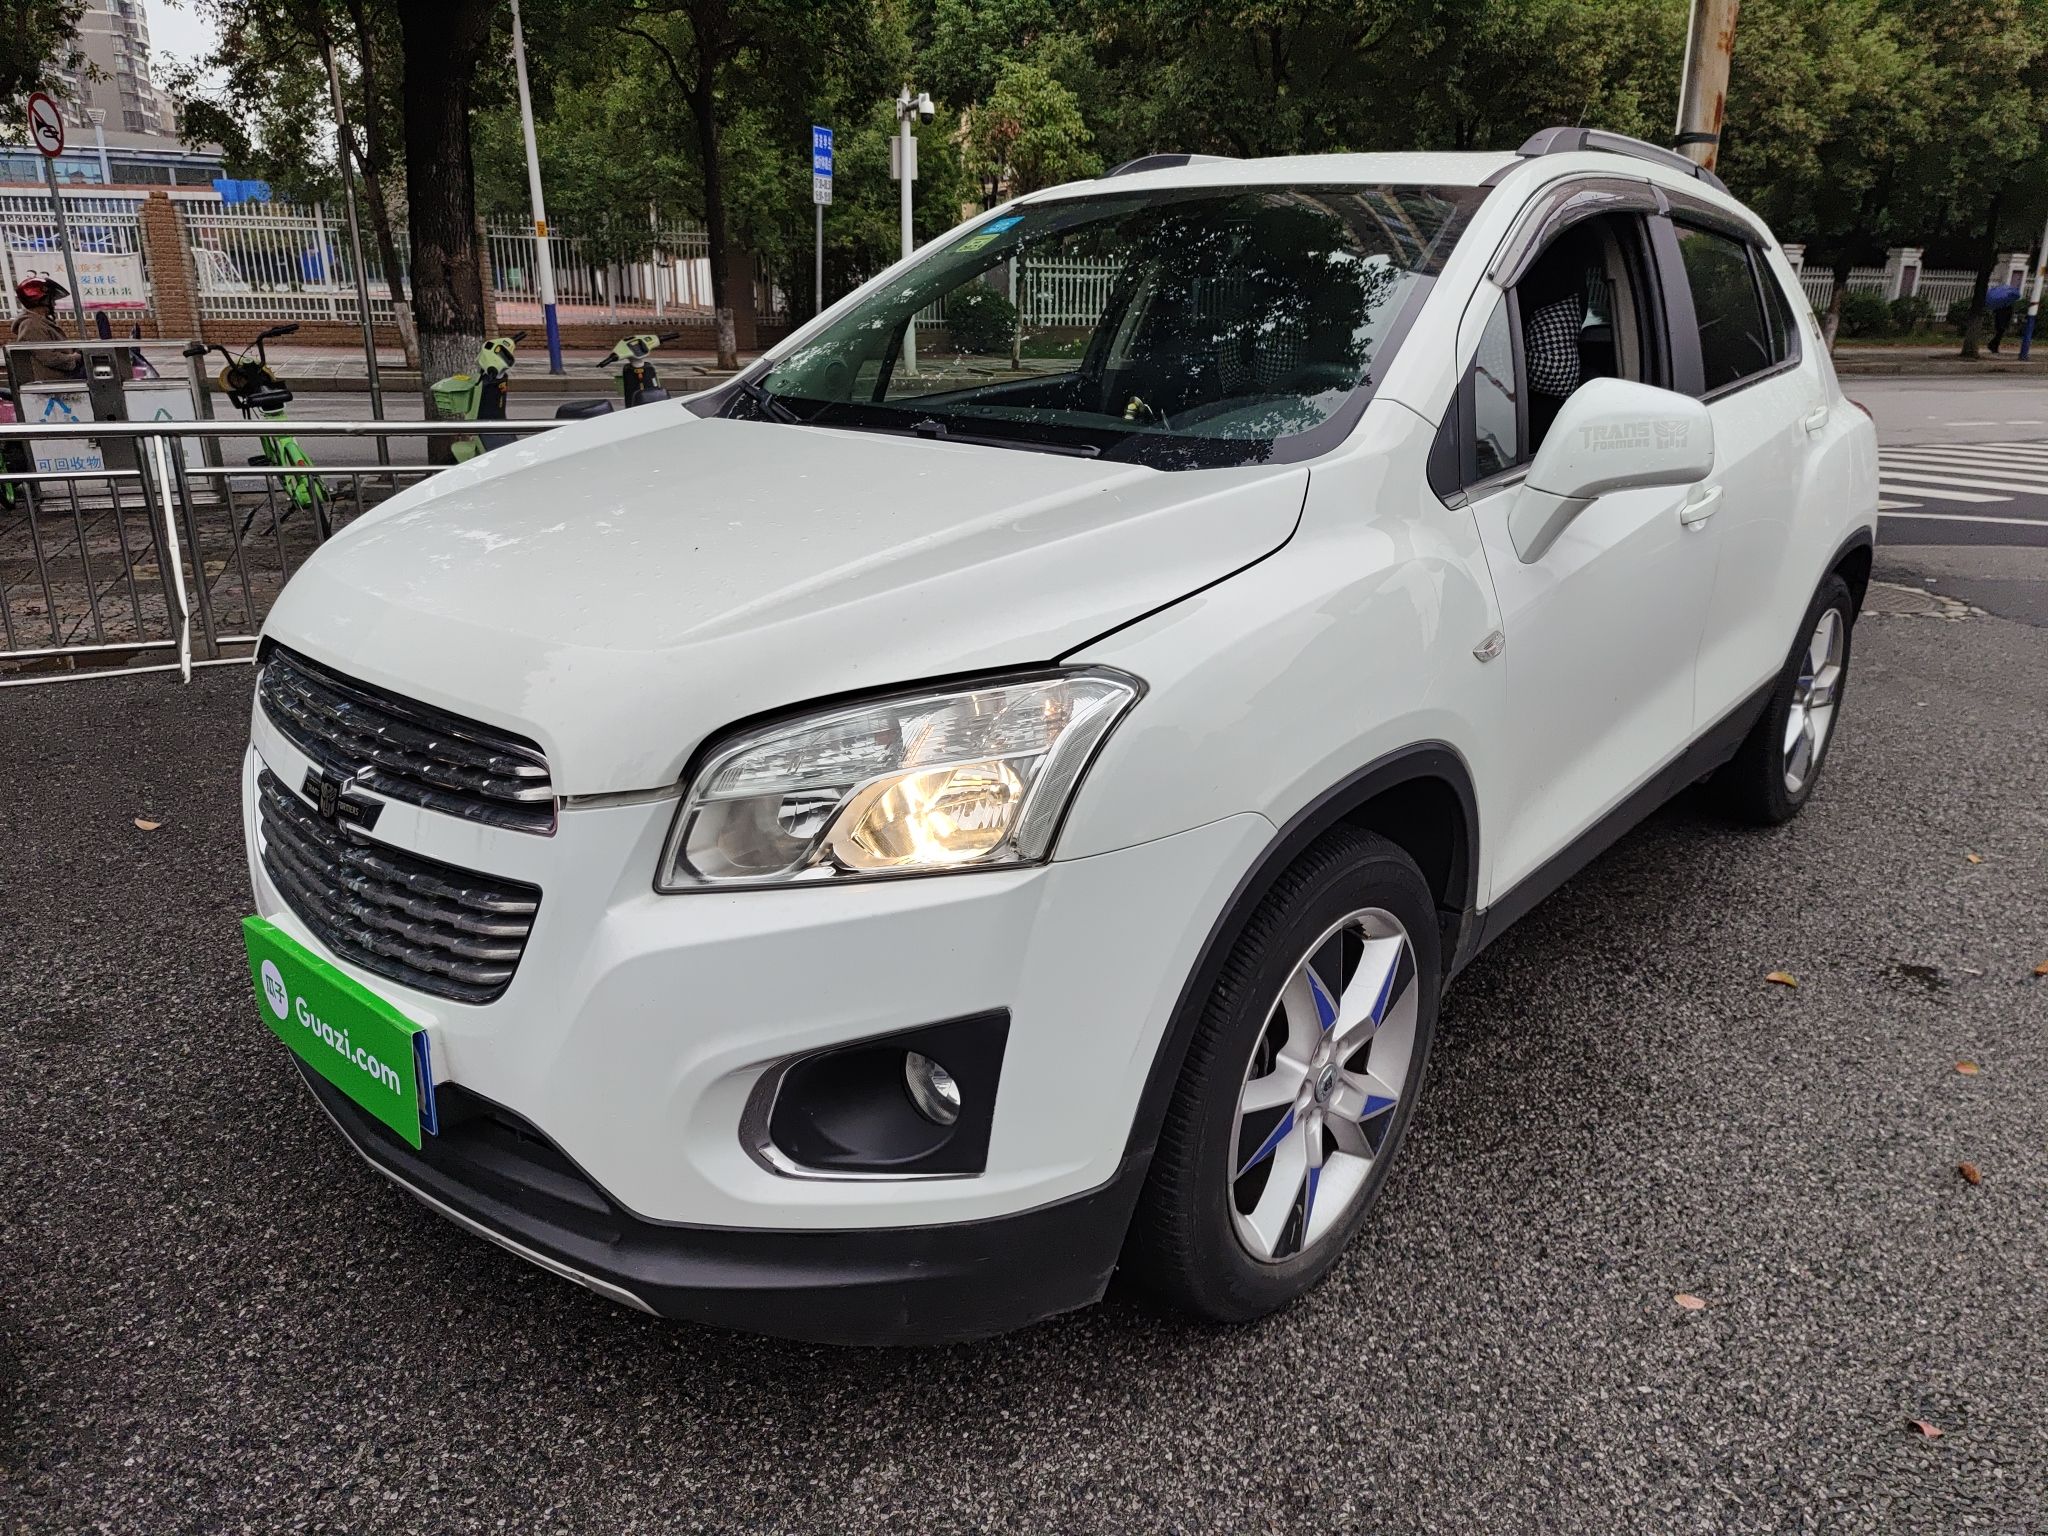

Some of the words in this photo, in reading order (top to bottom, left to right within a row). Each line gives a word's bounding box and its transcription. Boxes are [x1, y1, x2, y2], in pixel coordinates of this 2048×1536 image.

[36, 456, 101, 471] 可回收物
[265, 974, 285, 1004] 瓜子
[296, 996, 401, 1096] Guazi.com
